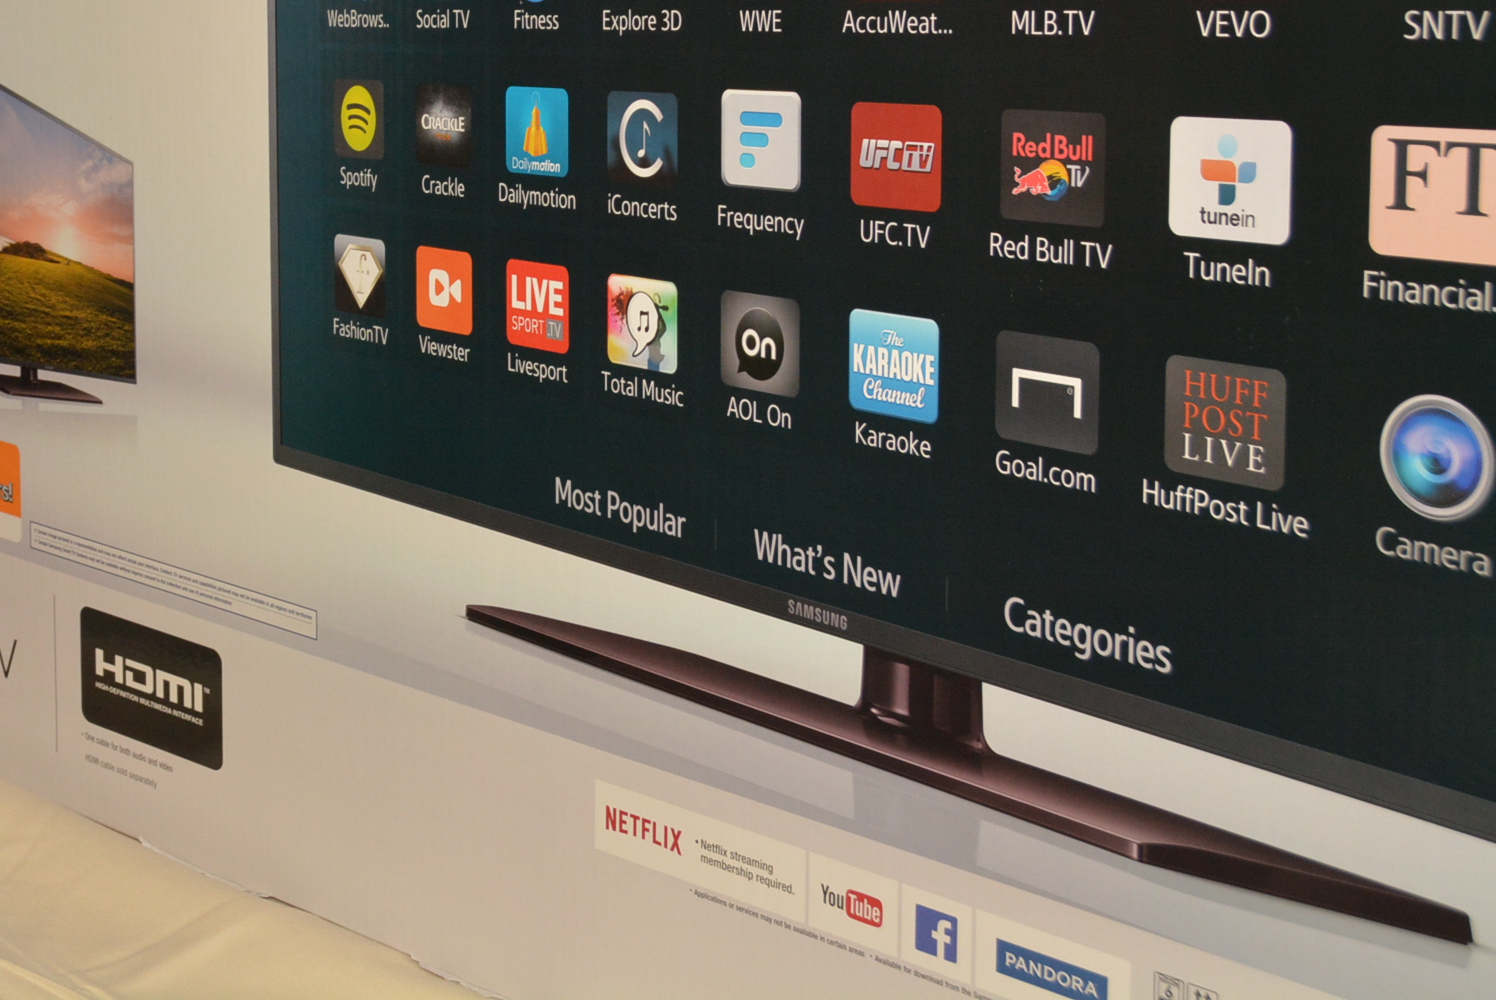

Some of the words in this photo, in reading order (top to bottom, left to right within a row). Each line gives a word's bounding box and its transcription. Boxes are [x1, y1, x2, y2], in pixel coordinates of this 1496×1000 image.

[416, 9, 450, 29] Social
[453, 9, 470, 27] TV
[514, 9, 559, 30] Fitness
[602, 10, 657, 36] Explore
[661, 10, 682, 31] 3D
[740, 10, 782, 32] WWE
[842, 10, 953, 34] AccuWeat...
[1012, 10, 1095, 35] MLB.TV
[1196, 10, 1272, 37] VEVO
[1404, 10, 1491, 41] SNTV
[860, 139, 903, 170] UFC
[1012, 132, 1051, 158] Red
[1055, 135, 1093, 161] Bull
[340, 167, 377, 192] Spotify
[512, 157, 560, 172] Dailymotion
[1067, 165, 1090, 187] TV
[1385, 138, 1496, 217] FT
[422, 175, 465, 197] Crackle
[498, 183, 576, 210] Dailymotion
[608, 195, 677, 221] iConcerts
[717, 205, 804, 240] Frequency
[1200, 206, 1255, 229] tunein
[860, 219, 930, 249] UFC.TV
[990, 232, 1028, 260] Red
[1036, 237, 1074, 265] Bull
[1080, 241, 1113, 269] TV
[1184, 252, 1271, 287] TuneIn
[511, 275, 564, 316] LIVE
[333, 318, 388, 345] FashionTV
[511, 316, 544, 335] SPORT
[880, 329, 904, 347] The
[419, 335, 470, 362] Viewster
[741, 328, 776, 361] On
[508, 353, 568, 383] Livesport
[853, 343, 935, 386] KARAOKE
[601, 371, 638, 397] Total
[642, 379, 684, 407] Music
[863, 377, 925, 408] Channel
[1184, 369, 1269, 407] HUFF
[727, 397, 762, 424] AOL
[767, 405, 792, 429] On
[1183, 401, 1268, 440] POST
[855, 421, 932, 459] Karaoke
[1182, 433, 1265, 474] LIVE
[995, 450, 1096, 494] Goal.com
[555, 476, 601, 516] Most
[607, 491, 686, 538] Popular
[1142, 478, 1249, 527] HuffPost
[1256, 501, 1311, 539] Live
[754, 529, 836, 580] What's
[843, 552, 901, 598] New
[1375, 526, 1493, 577] Camera
[788, 599, 848, 631] SAMSUNG
[1004, 597, 1174, 674] Categories
[605, 805, 682, 856] NETFLIX
[701, 839, 727, 857] Netflix
[730, 850, 773, 875] streaming
[701, 854, 753, 881] membership
[756, 874, 795, 895] required.
[694, 888, 727, 908] Applications
[728, 901, 734, 909] or
[736, 904, 758, 918] services
[760, 913, 772, 925] may
[774, 918, 783, 927] not
[784, 921, 791, 930] be
[793, 925, 818, 940] available
[1005, 951, 1098, 998] PANDORA
